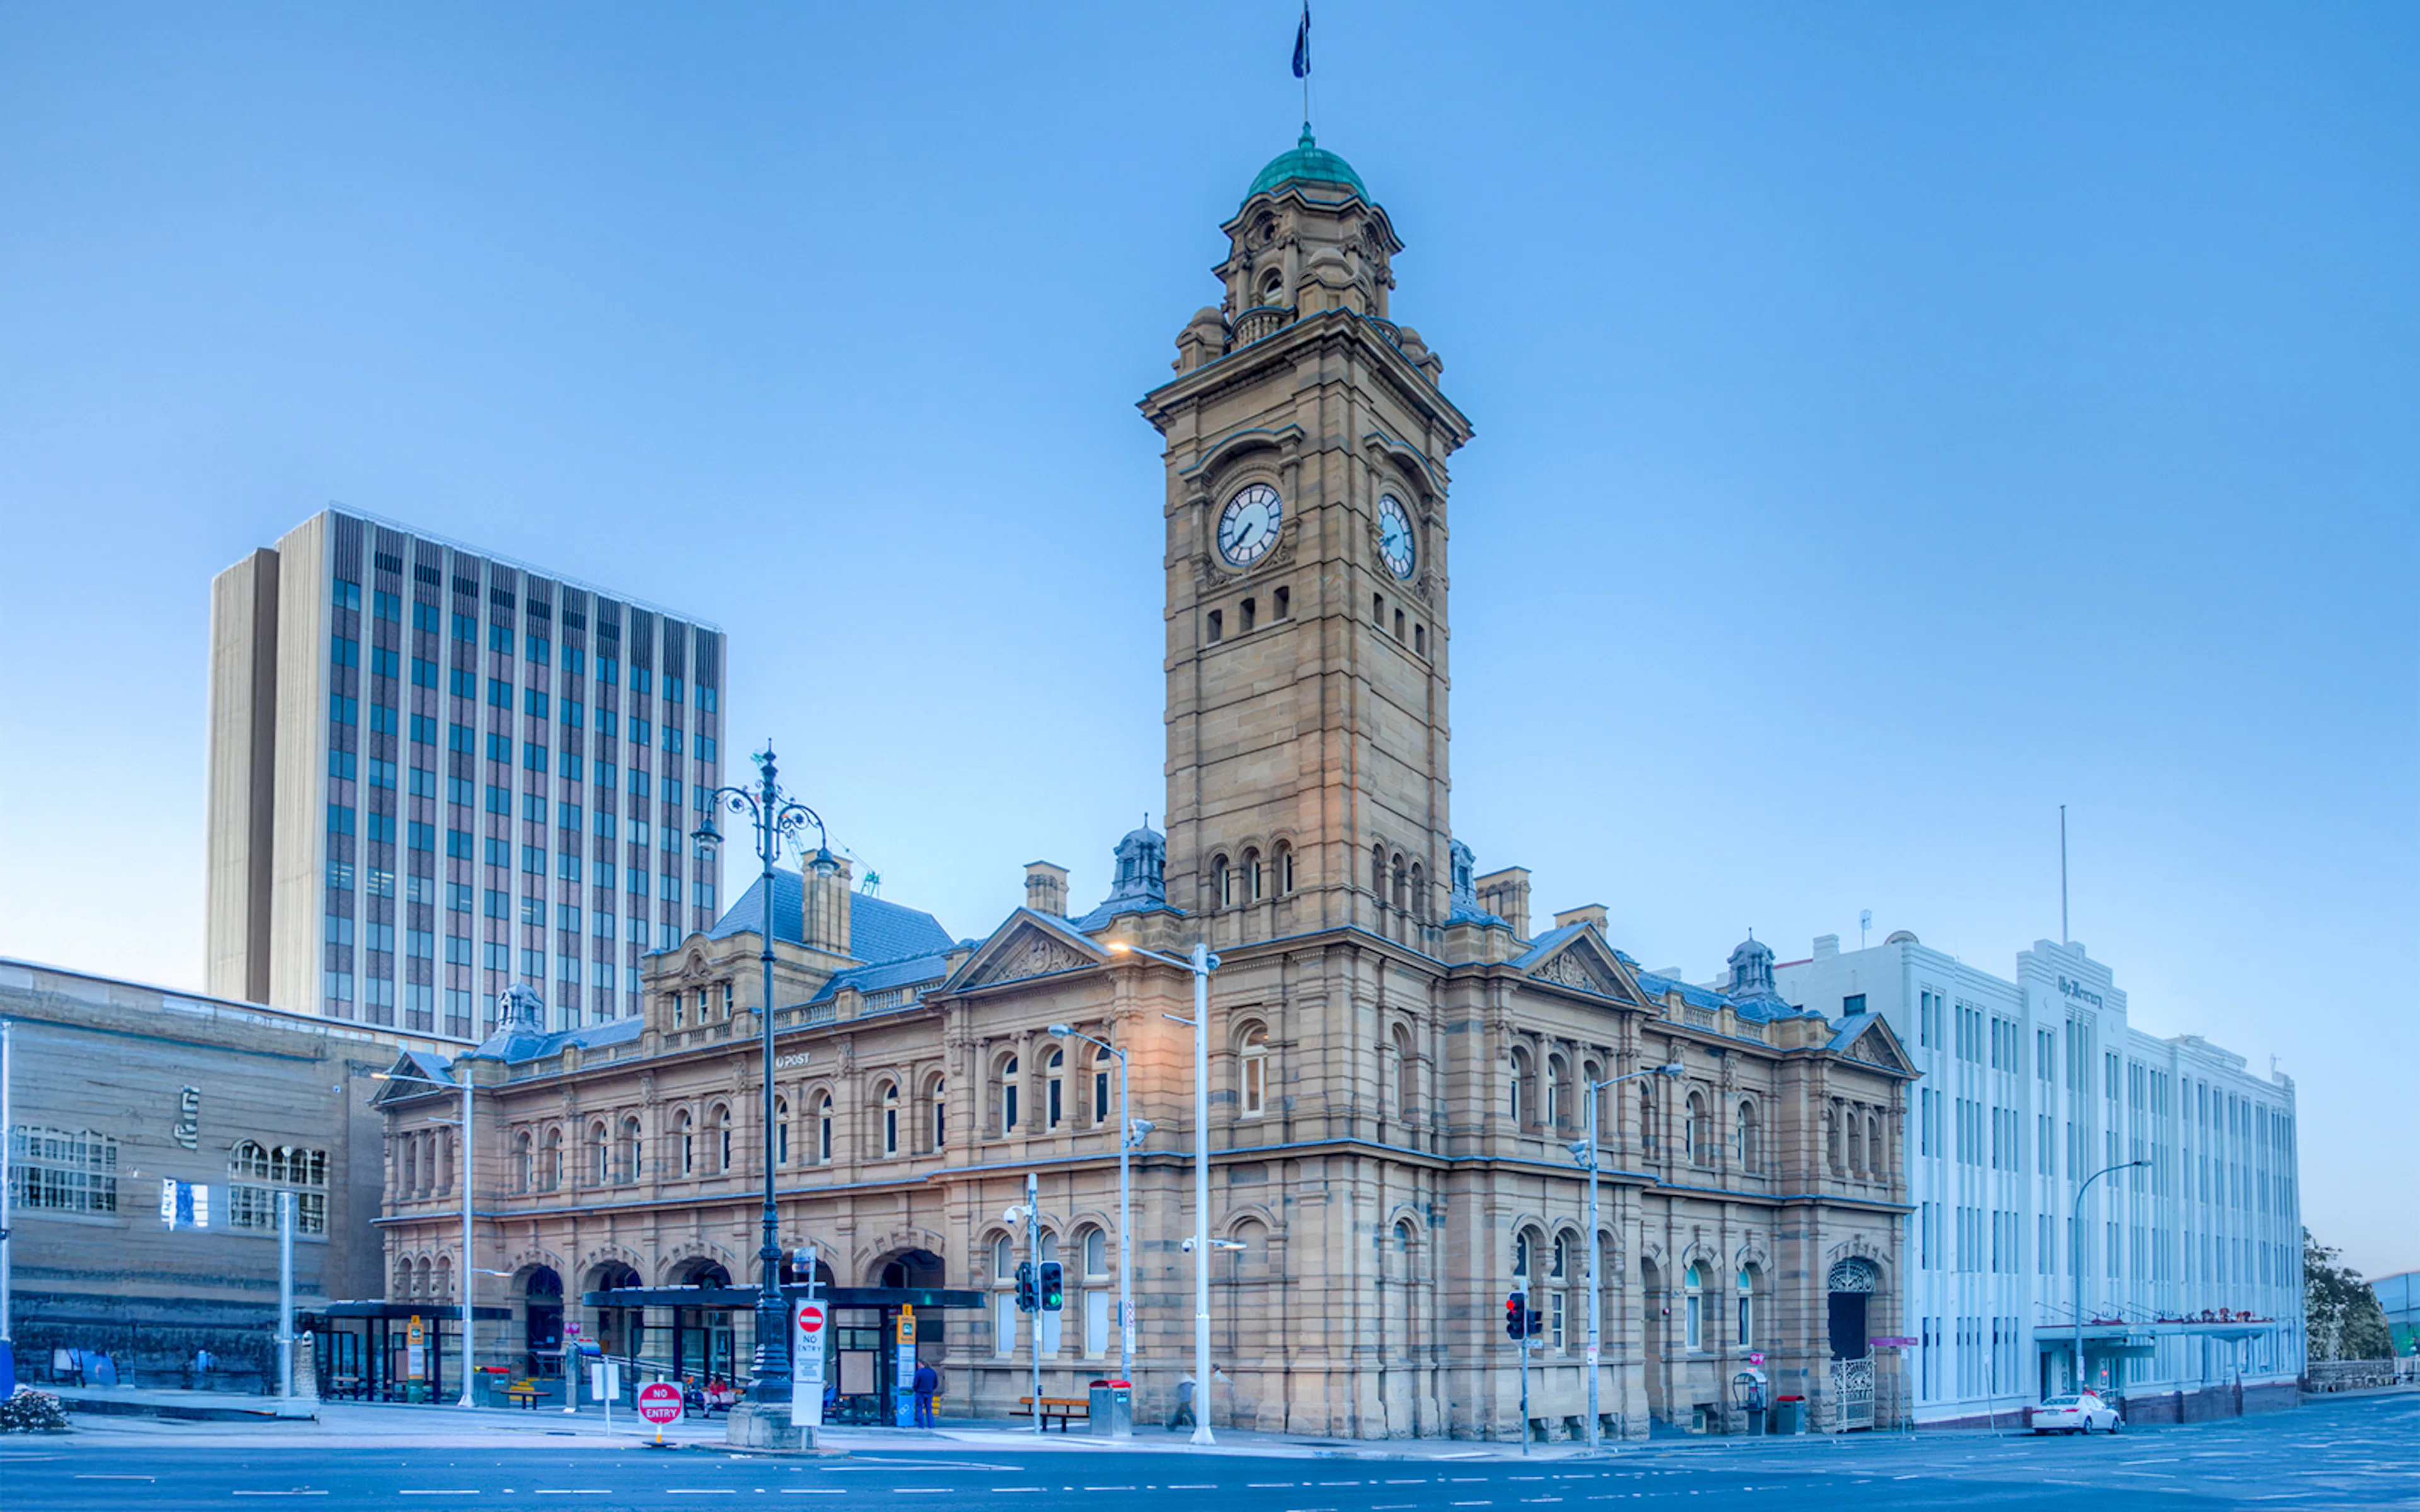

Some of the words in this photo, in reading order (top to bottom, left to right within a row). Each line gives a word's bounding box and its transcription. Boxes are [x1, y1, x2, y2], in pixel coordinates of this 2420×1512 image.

[785, 1053, 810, 1068] POST
[803, 1335, 817, 1344] NO
[653, 1389, 668, 1398] NO
[646, 1408, 677, 1418] ENTRY
